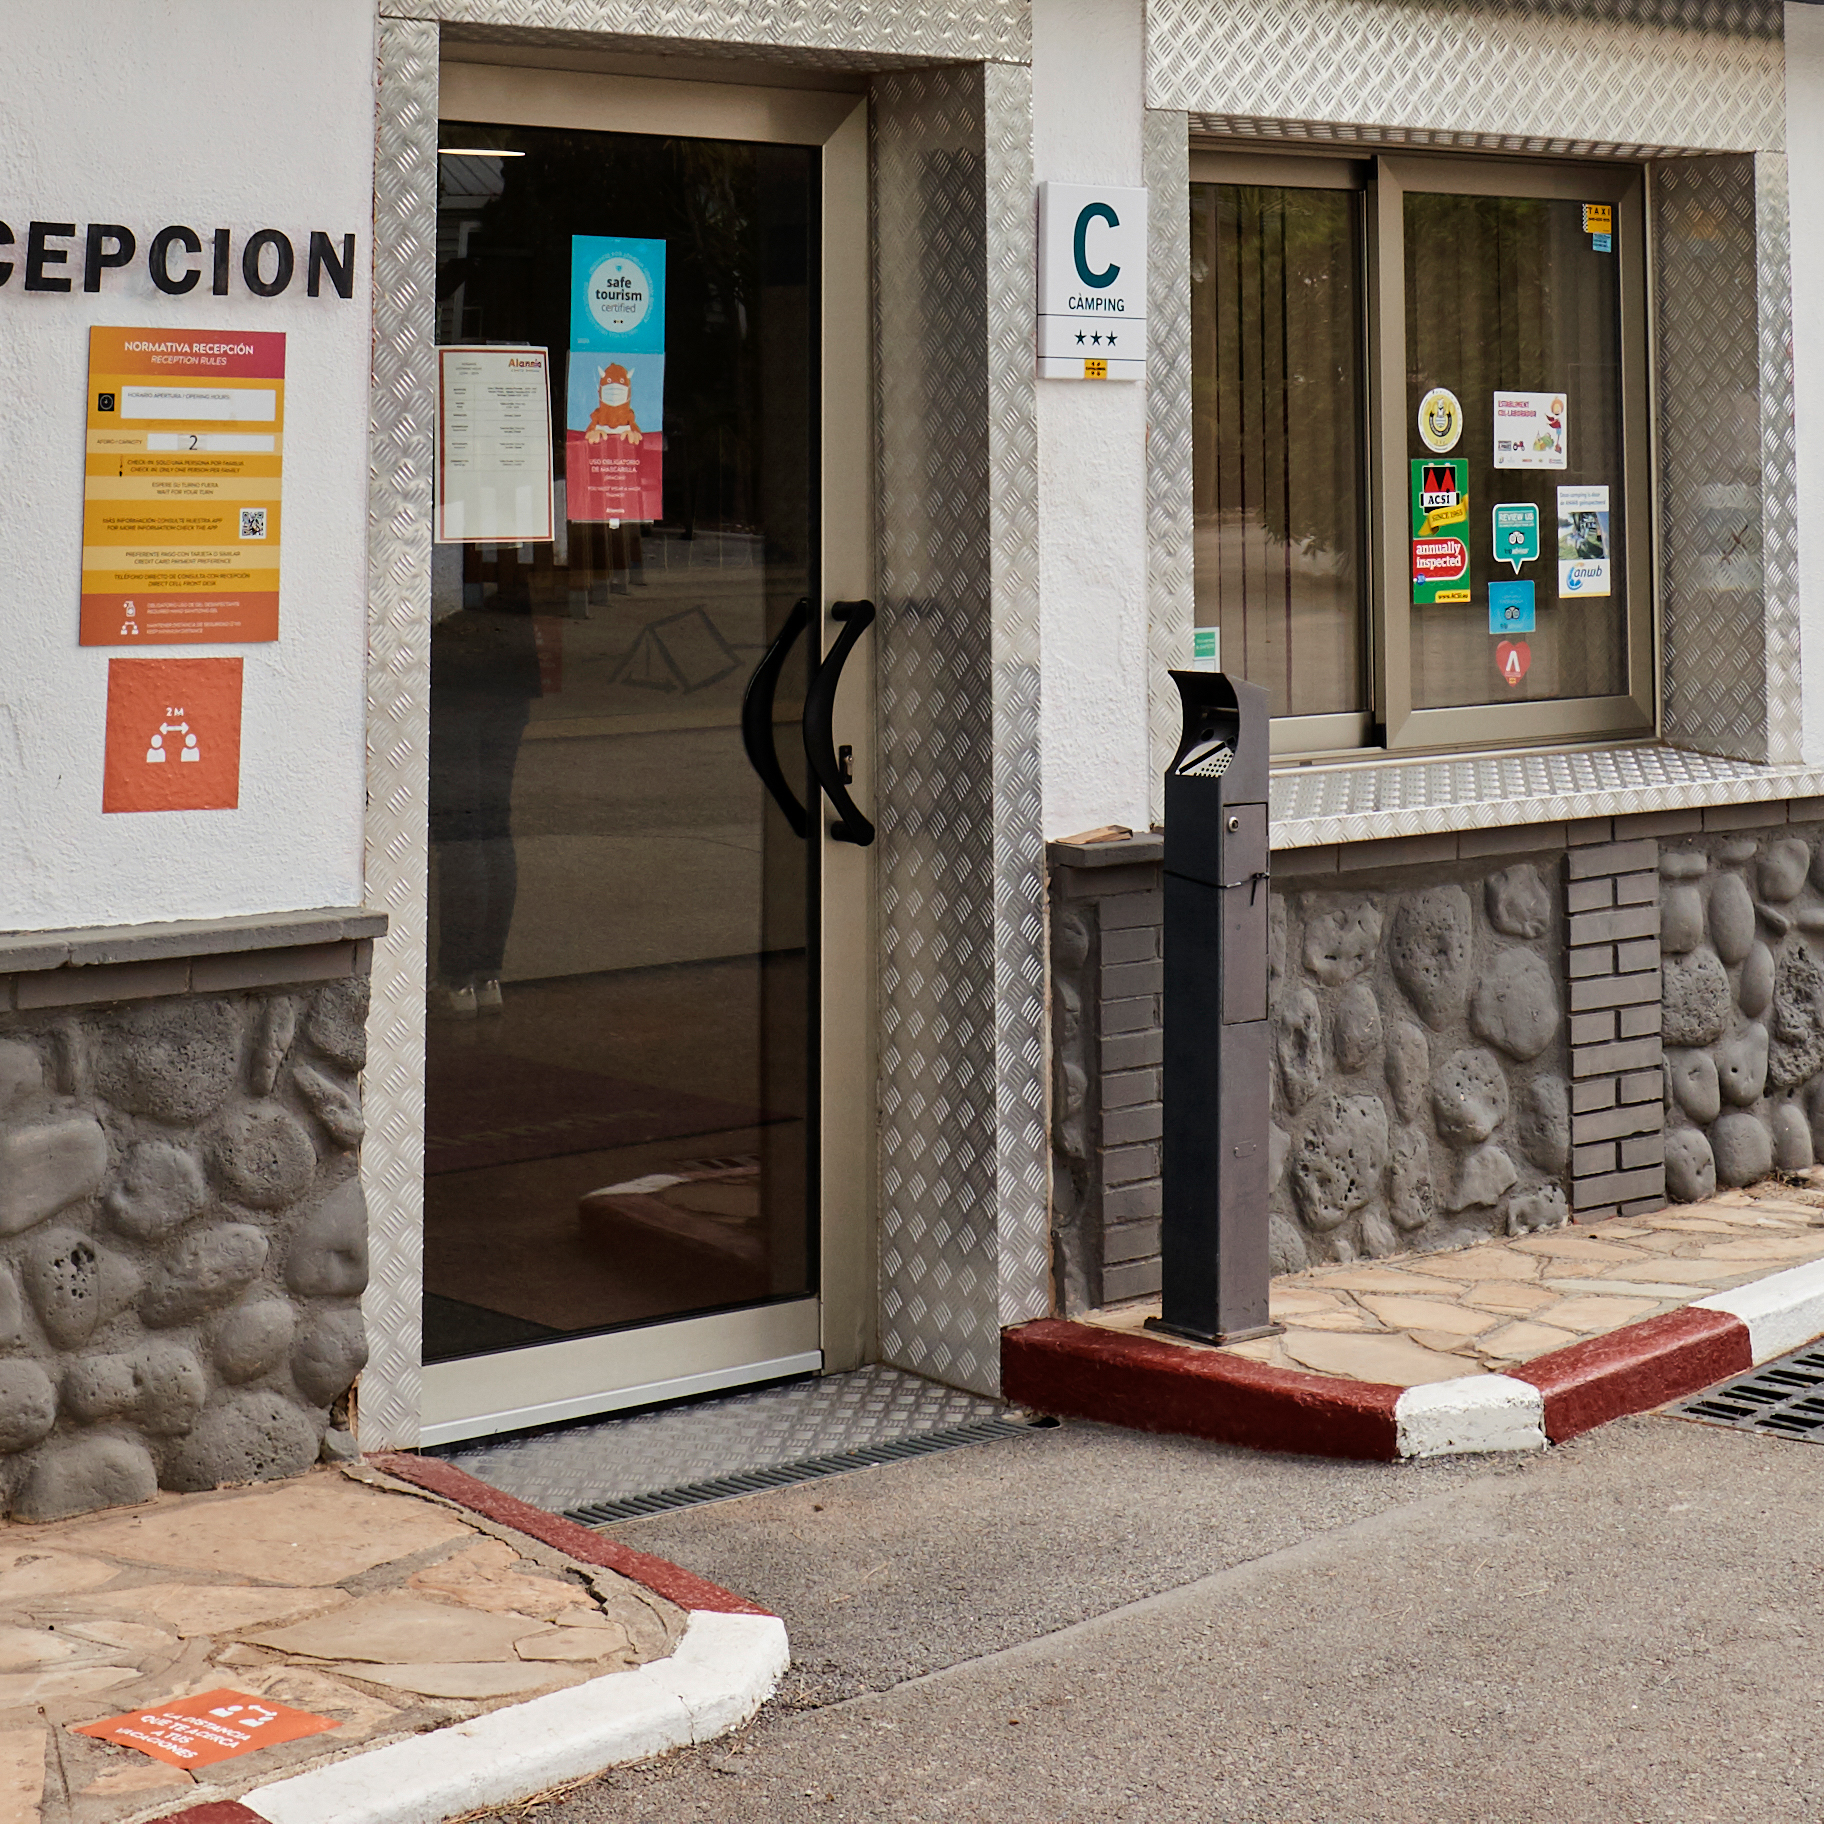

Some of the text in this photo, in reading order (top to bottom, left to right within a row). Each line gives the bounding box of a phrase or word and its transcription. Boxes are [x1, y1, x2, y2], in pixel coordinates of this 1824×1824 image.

[1586, 207, 1611, 216] TAXI
[1073, 202, 1121, 289] C
[607, 276, 632, 288] safe
[595, 289, 642, 301] tourism
[601, 302, 636, 313] certified
[1068, 293, 1125, 312] CÀMPING
[124, 341, 254, 355] NORMATIVA RECEPCIÓN
[151, 355, 227, 366] RECEPTION RULES
[188, 435, 198, 451] 2
[1416, 541, 1461, 556] annually
[1416, 555, 1462, 570] inspected
[1574, 565, 1603, 578] anwb
[166, 707, 184, 717] 2 M
[140, 1715, 240, 1749] QUE TE ACERCA
[181, 1716, 251, 1741] DISTANCIA
[115, 1727, 198, 1759] VACACIONES
[164, 1732, 194, 1744] TUS
